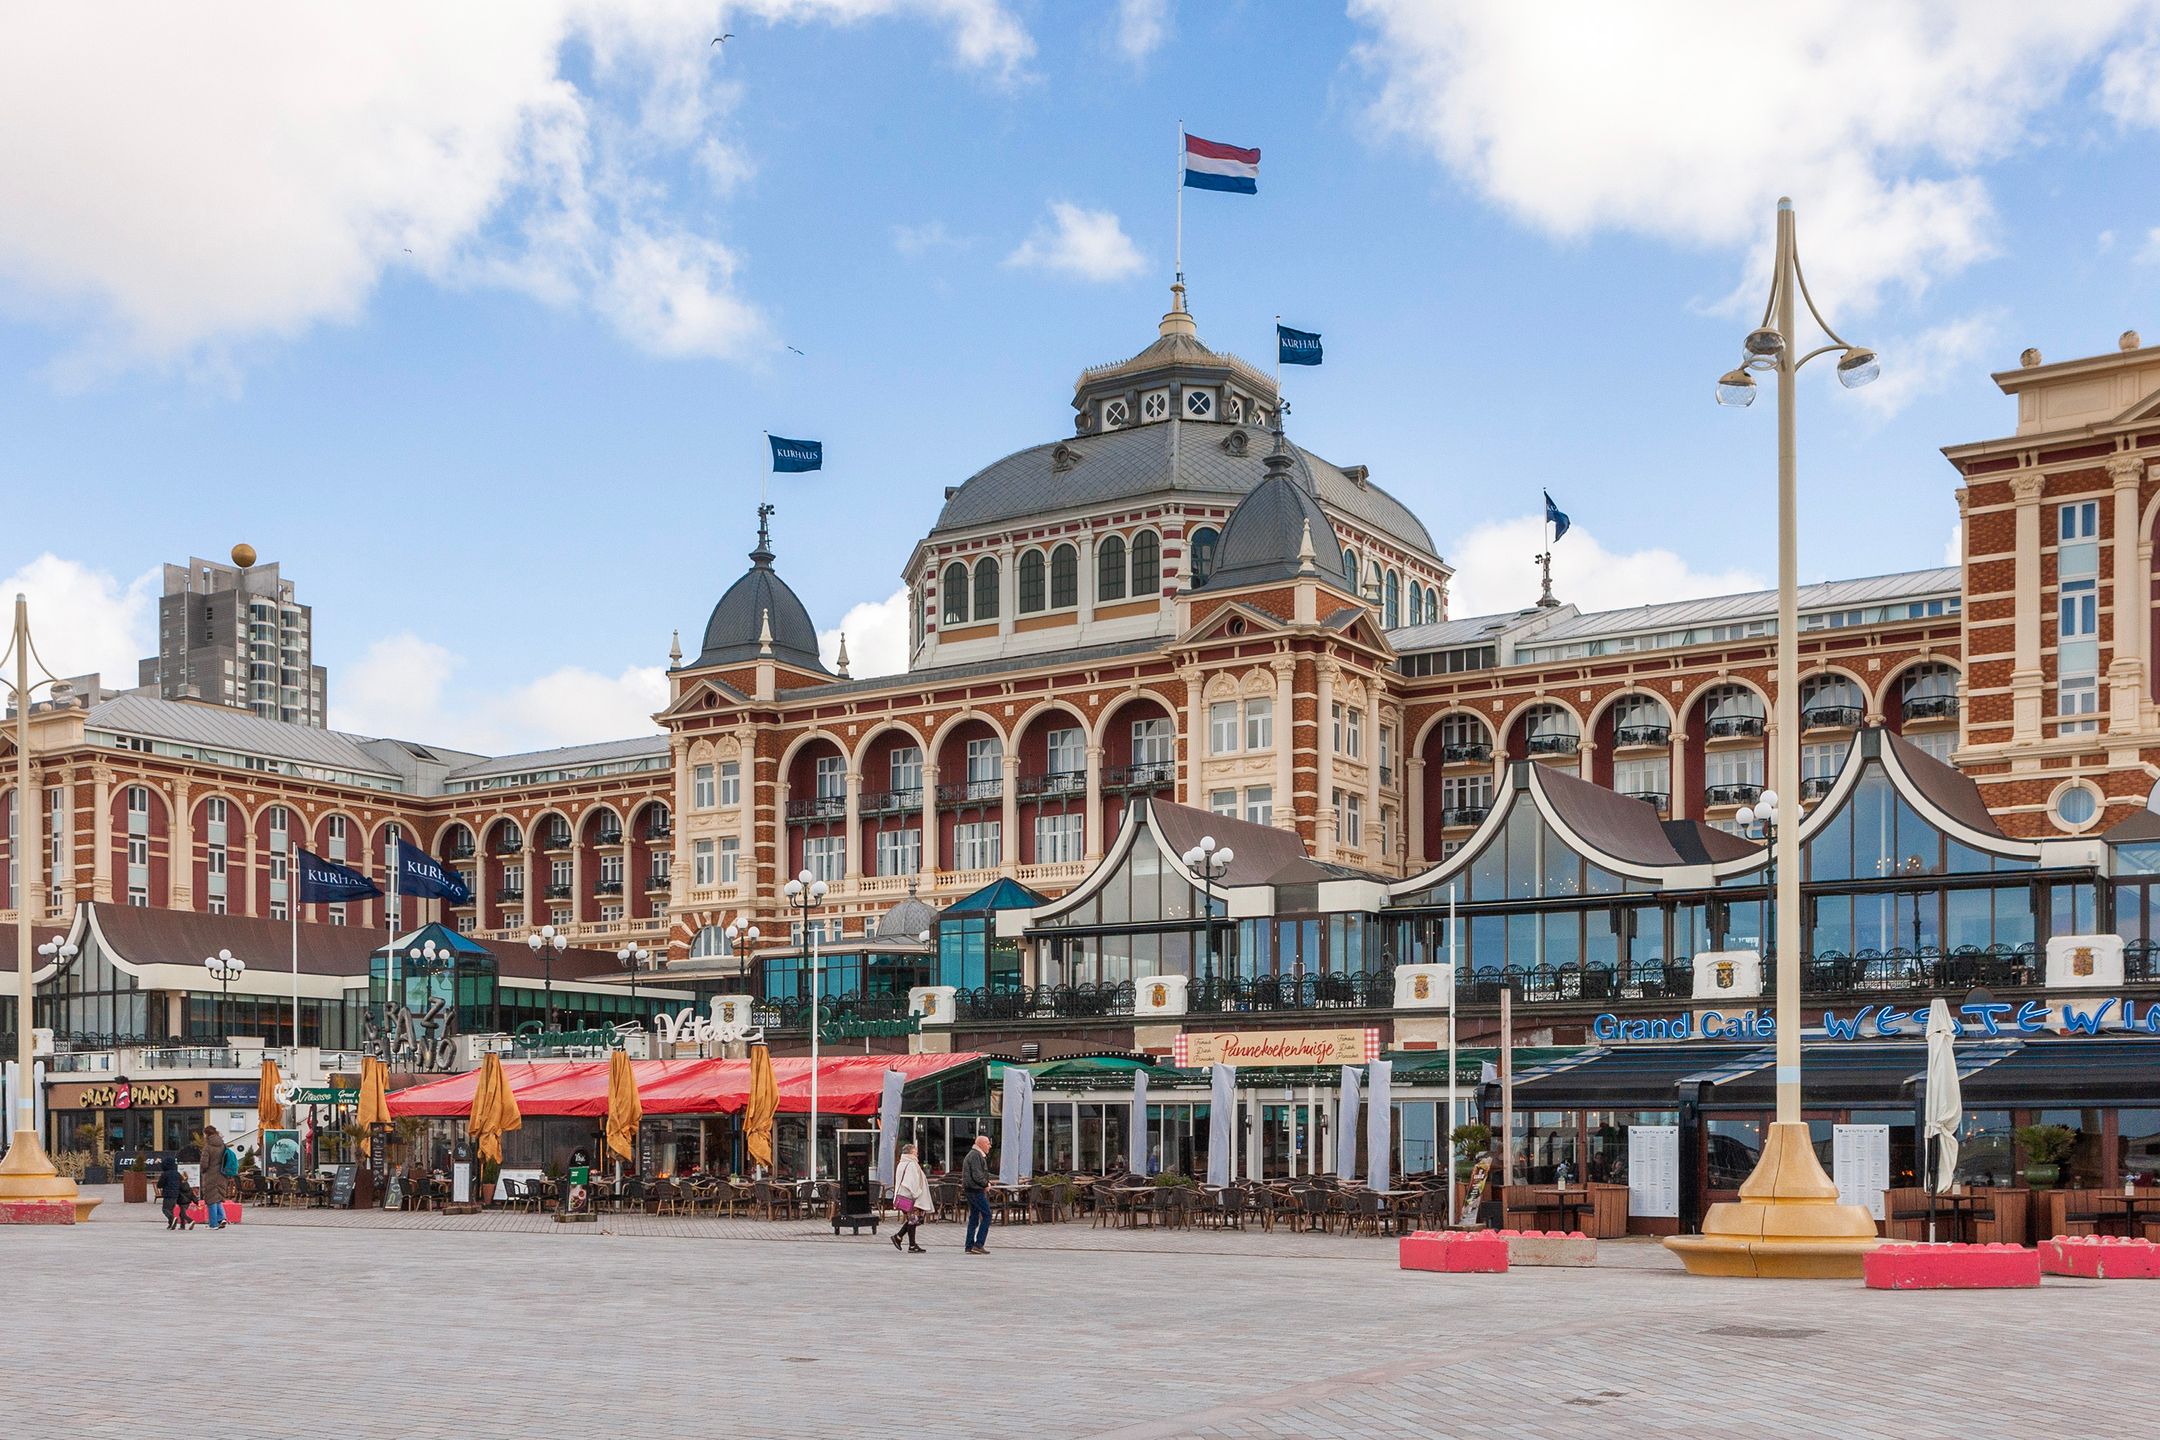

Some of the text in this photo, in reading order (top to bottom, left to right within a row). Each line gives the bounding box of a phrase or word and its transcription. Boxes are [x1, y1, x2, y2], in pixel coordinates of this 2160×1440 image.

[777, 448, 818, 460] KURHAUS
[654, 1007, 762, 1044] Vitesse
[797, 1005, 929, 1046] Restaurant
[1593, 1008, 1776, 1040] Grand Café
[79, 1086, 116, 1108] CRAZY
[130, 1084, 176, 1106] PIANOS
